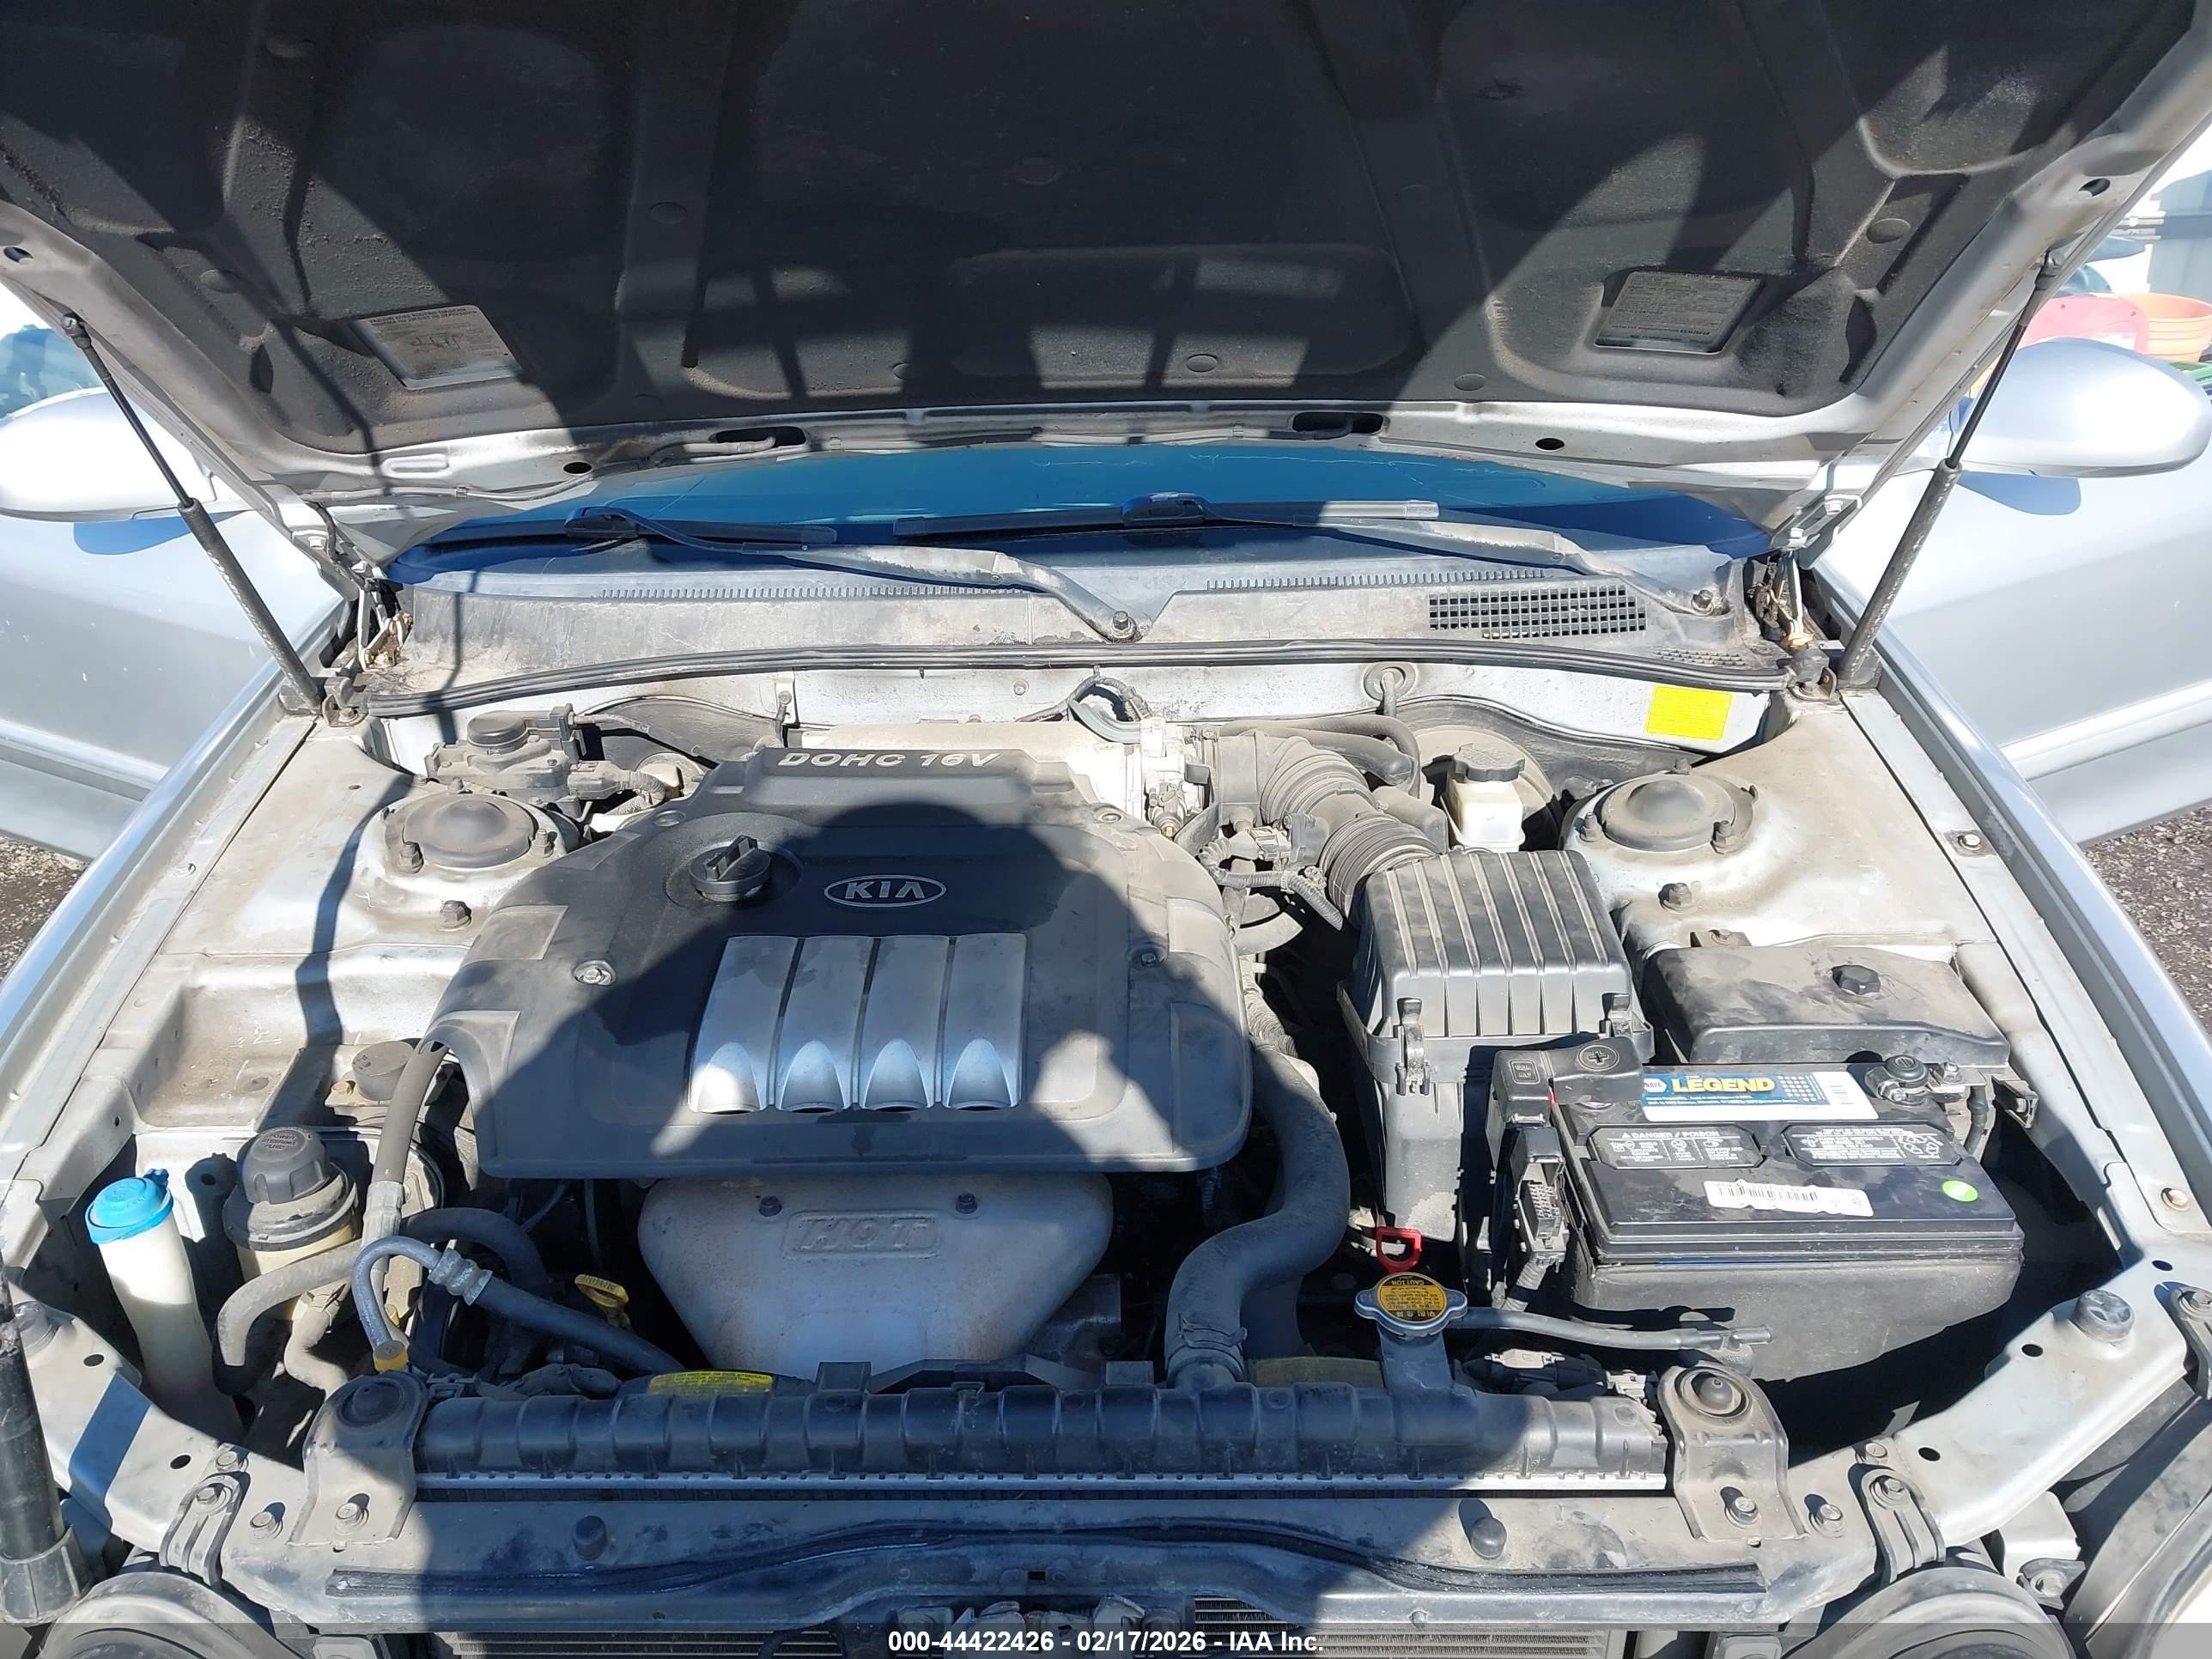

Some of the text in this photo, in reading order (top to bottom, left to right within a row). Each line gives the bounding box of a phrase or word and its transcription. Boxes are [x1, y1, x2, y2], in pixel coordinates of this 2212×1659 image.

[777, 752, 1000, 768] DOHC 16V
[844, 881, 926, 899] KIA
[1672, 1076, 1776, 1093] LEGEND
[795, 1215, 931, 1250] HOT
